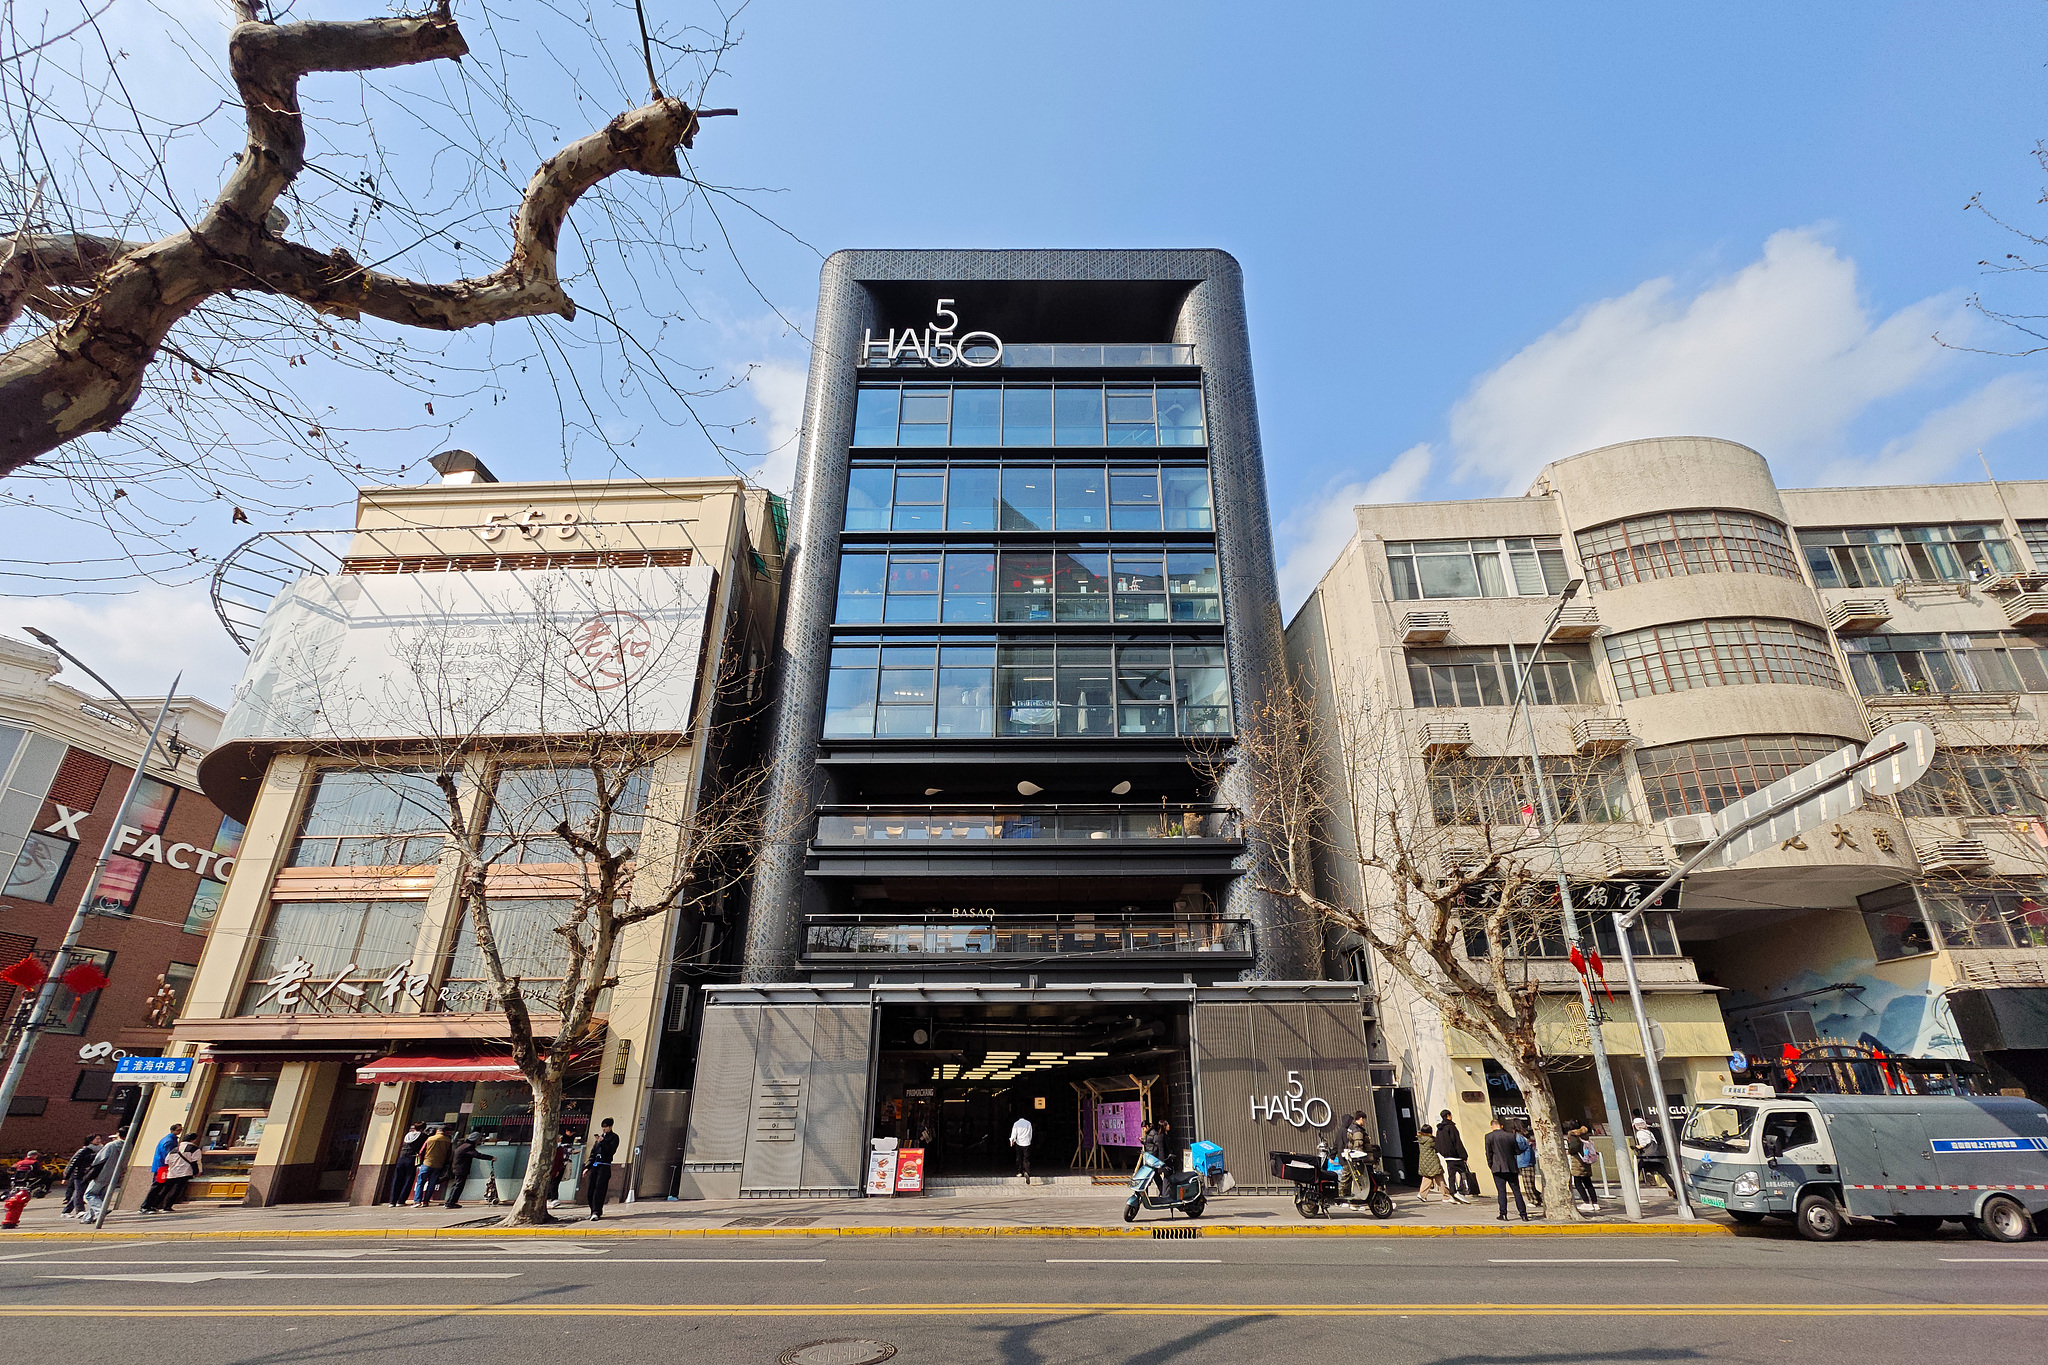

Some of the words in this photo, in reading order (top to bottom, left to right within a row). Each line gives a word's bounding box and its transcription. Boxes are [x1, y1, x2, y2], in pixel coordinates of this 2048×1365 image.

[44, 804, 91, 840] X
[952, 908, 996, 918] BASAO
[255, 955, 430, 1008] 老人和
[132, 1060, 176, 1071] 淮海中路
